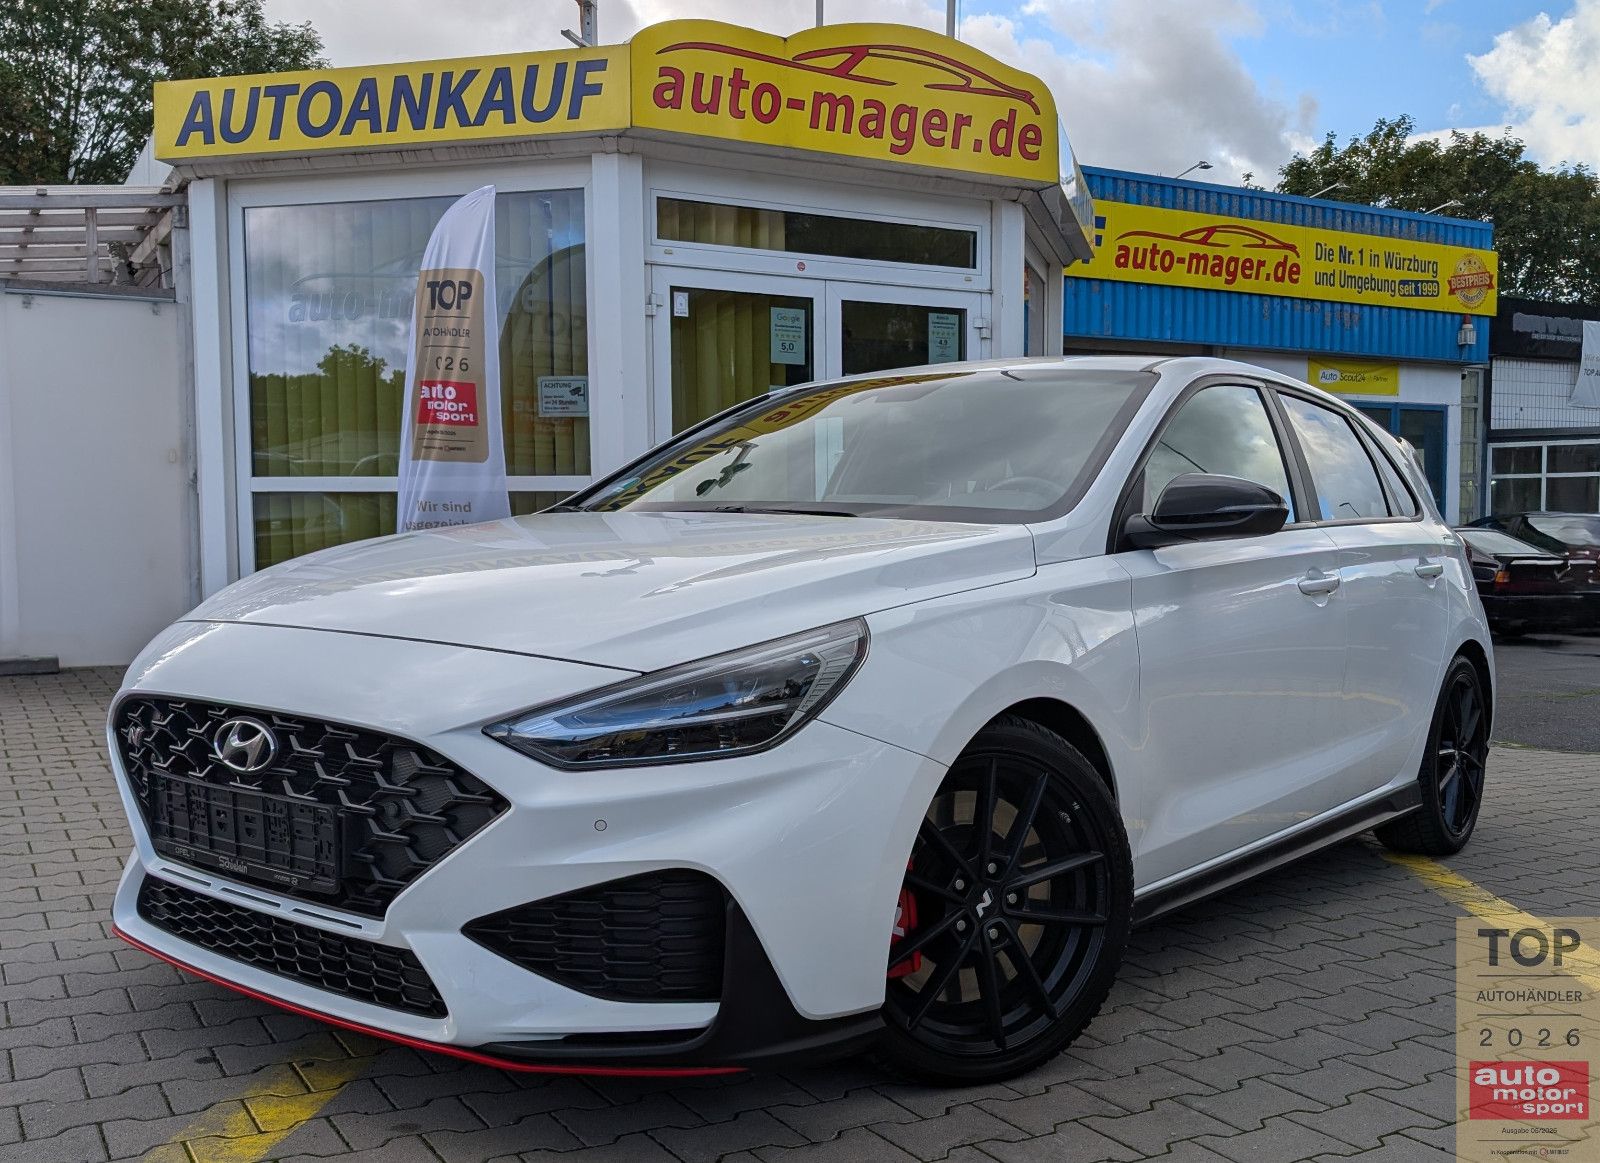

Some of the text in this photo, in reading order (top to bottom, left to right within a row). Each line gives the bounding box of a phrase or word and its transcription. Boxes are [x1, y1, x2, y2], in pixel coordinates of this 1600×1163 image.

[175, 58, 608, 147] AUTOANKAUF
[652, 66, 1043, 162] auto-mager.de
[1114, 242, 1301, 286] auto-mager.de
[1315, 243, 1439, 278] Die Nr. 1 in Würzburg
[427, 280, 472, 310] TOP
[1314, 270, 1439, 297] und Umgebung seit 1999
[1451, 273, 1490, 289] BESTPREIS
[781, 342, 795, 351] 5,0
[436, 411, 475, 422] sport
[417, 499, 472, 512] Wir sind
